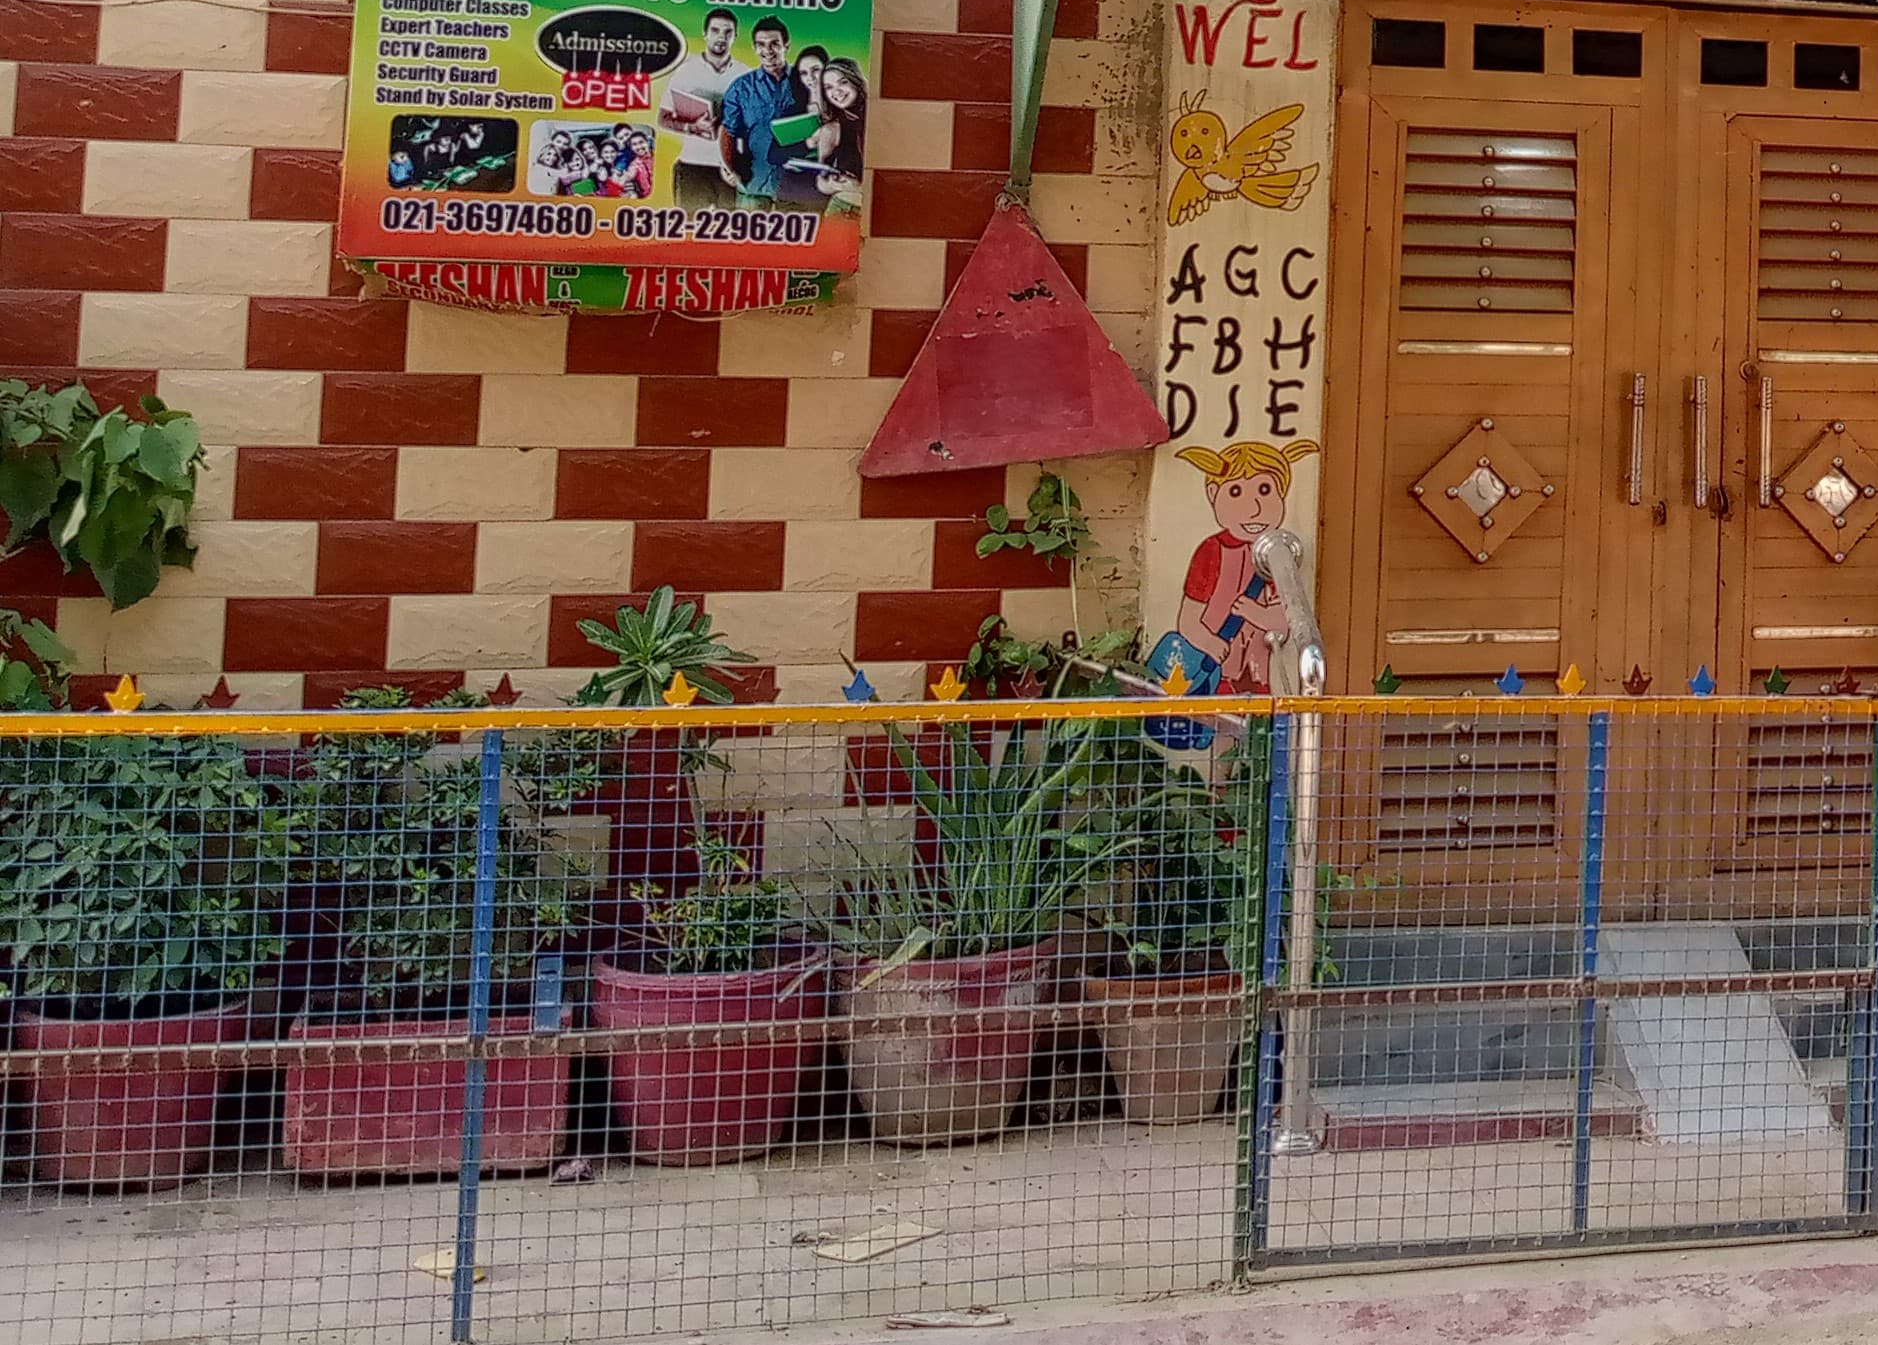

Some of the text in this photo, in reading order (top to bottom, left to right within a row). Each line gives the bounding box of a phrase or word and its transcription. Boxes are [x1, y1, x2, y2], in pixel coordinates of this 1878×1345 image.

[381, 17, 509, 38] Expert Teachers
[379, 40, 487, 61] CCTV Camera
[548, 31, 669, 56] Admissions
[377, 64, 498, 86] Security Guard
[376, 87, 553, 111] Stand by Solar System
[562, 78, 650, 109] OPEN
[382, 199, 595, 238] 021-36974680
[616, 206, 818, 245] 0312-2296207
[1167, 243, 1319, 305] A G C
[622, 268, 788, 312] ZEESHAN
[1165, 313, 1316, 375] F B H
[1166, 379, 1198, 440] D
[1265, 379, 1305, 438] E
